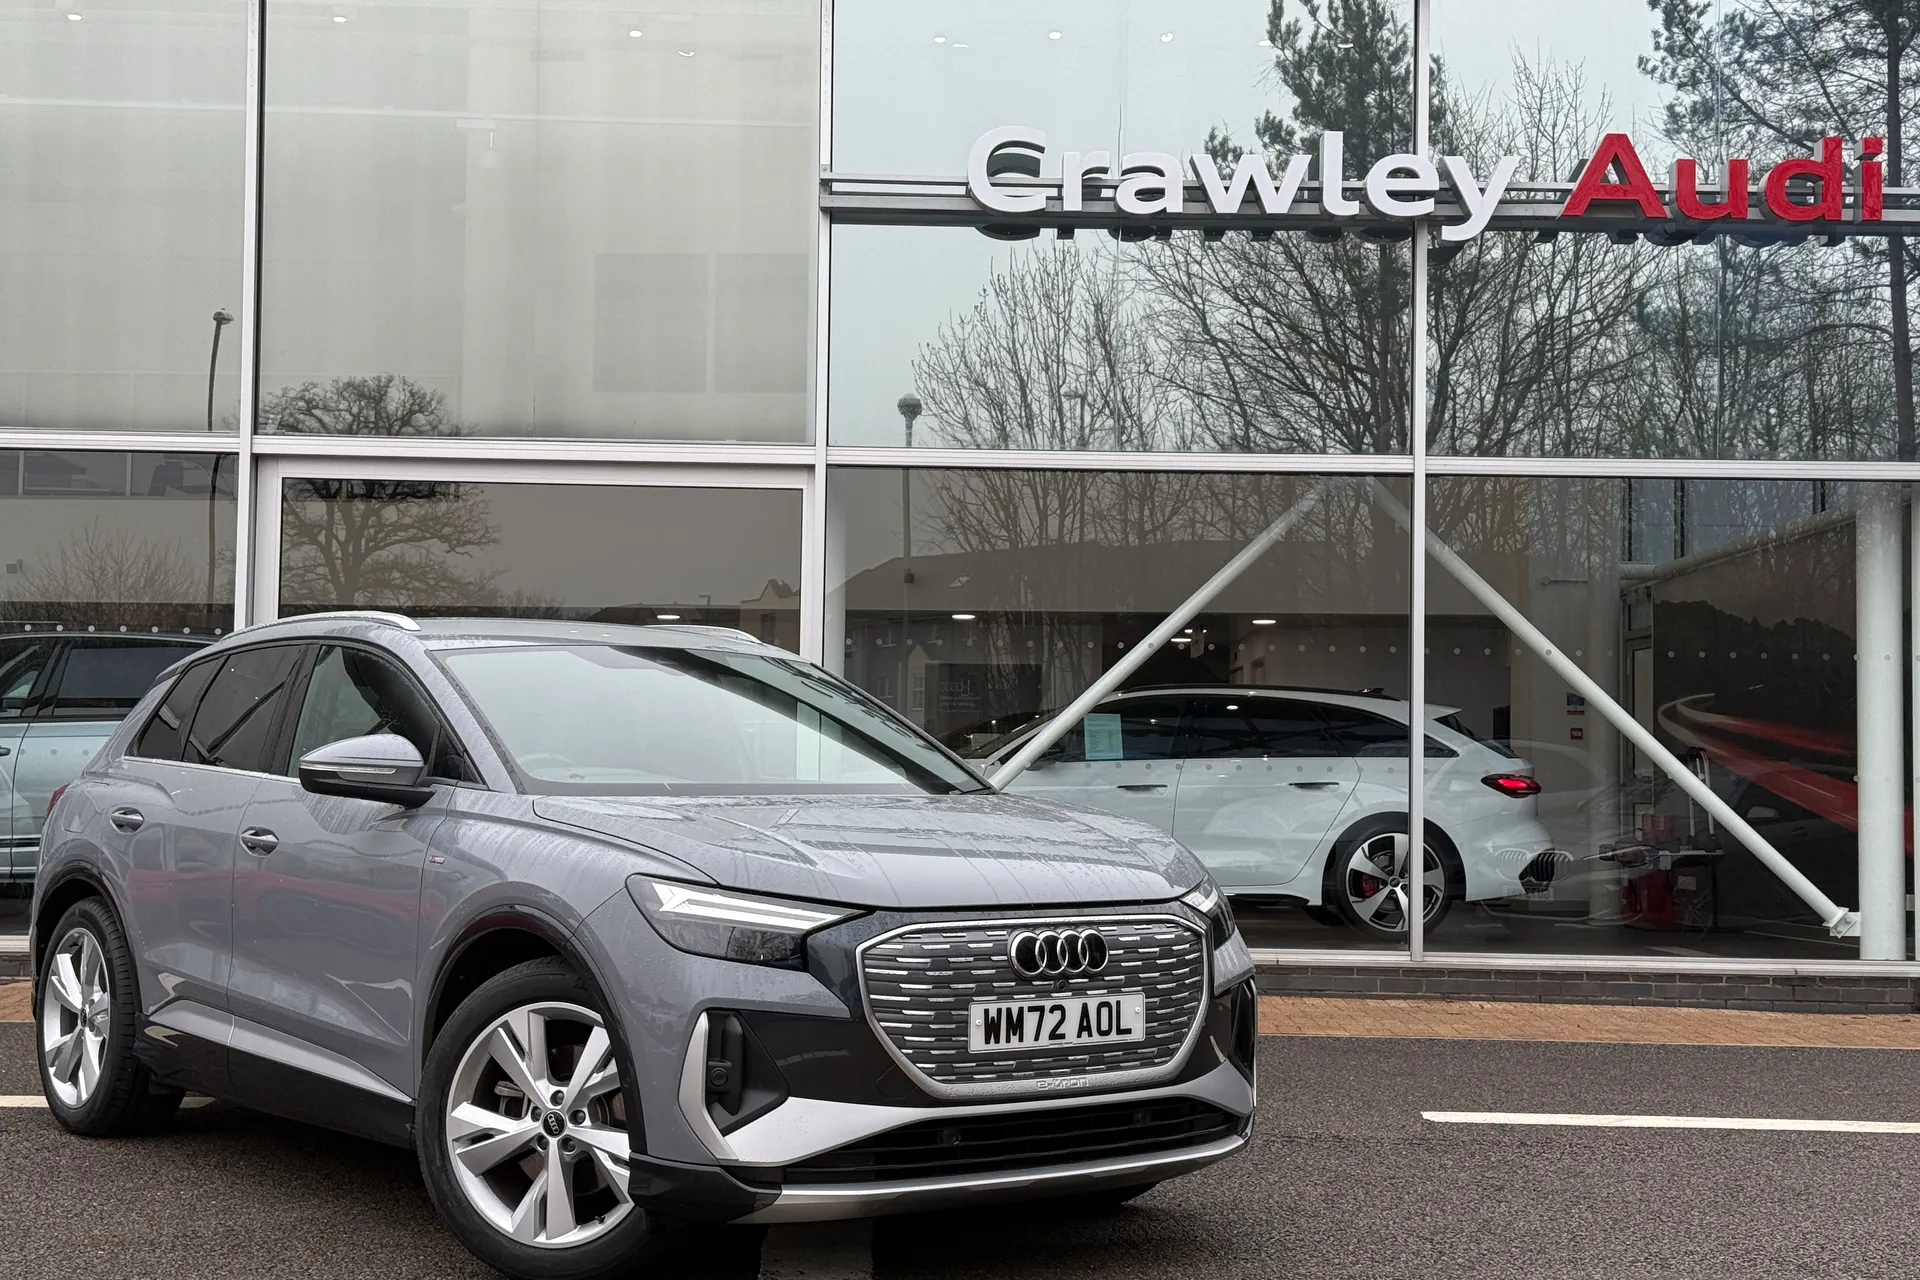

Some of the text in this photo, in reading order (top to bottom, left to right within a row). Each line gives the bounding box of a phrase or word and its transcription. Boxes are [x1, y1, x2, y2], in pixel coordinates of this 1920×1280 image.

[968, 126, 1884, 242] Crawley Audi
[984, 1000, 1132, 1045] WM72 AOL
[1036, 1077, 1090, 1091] e-tron
